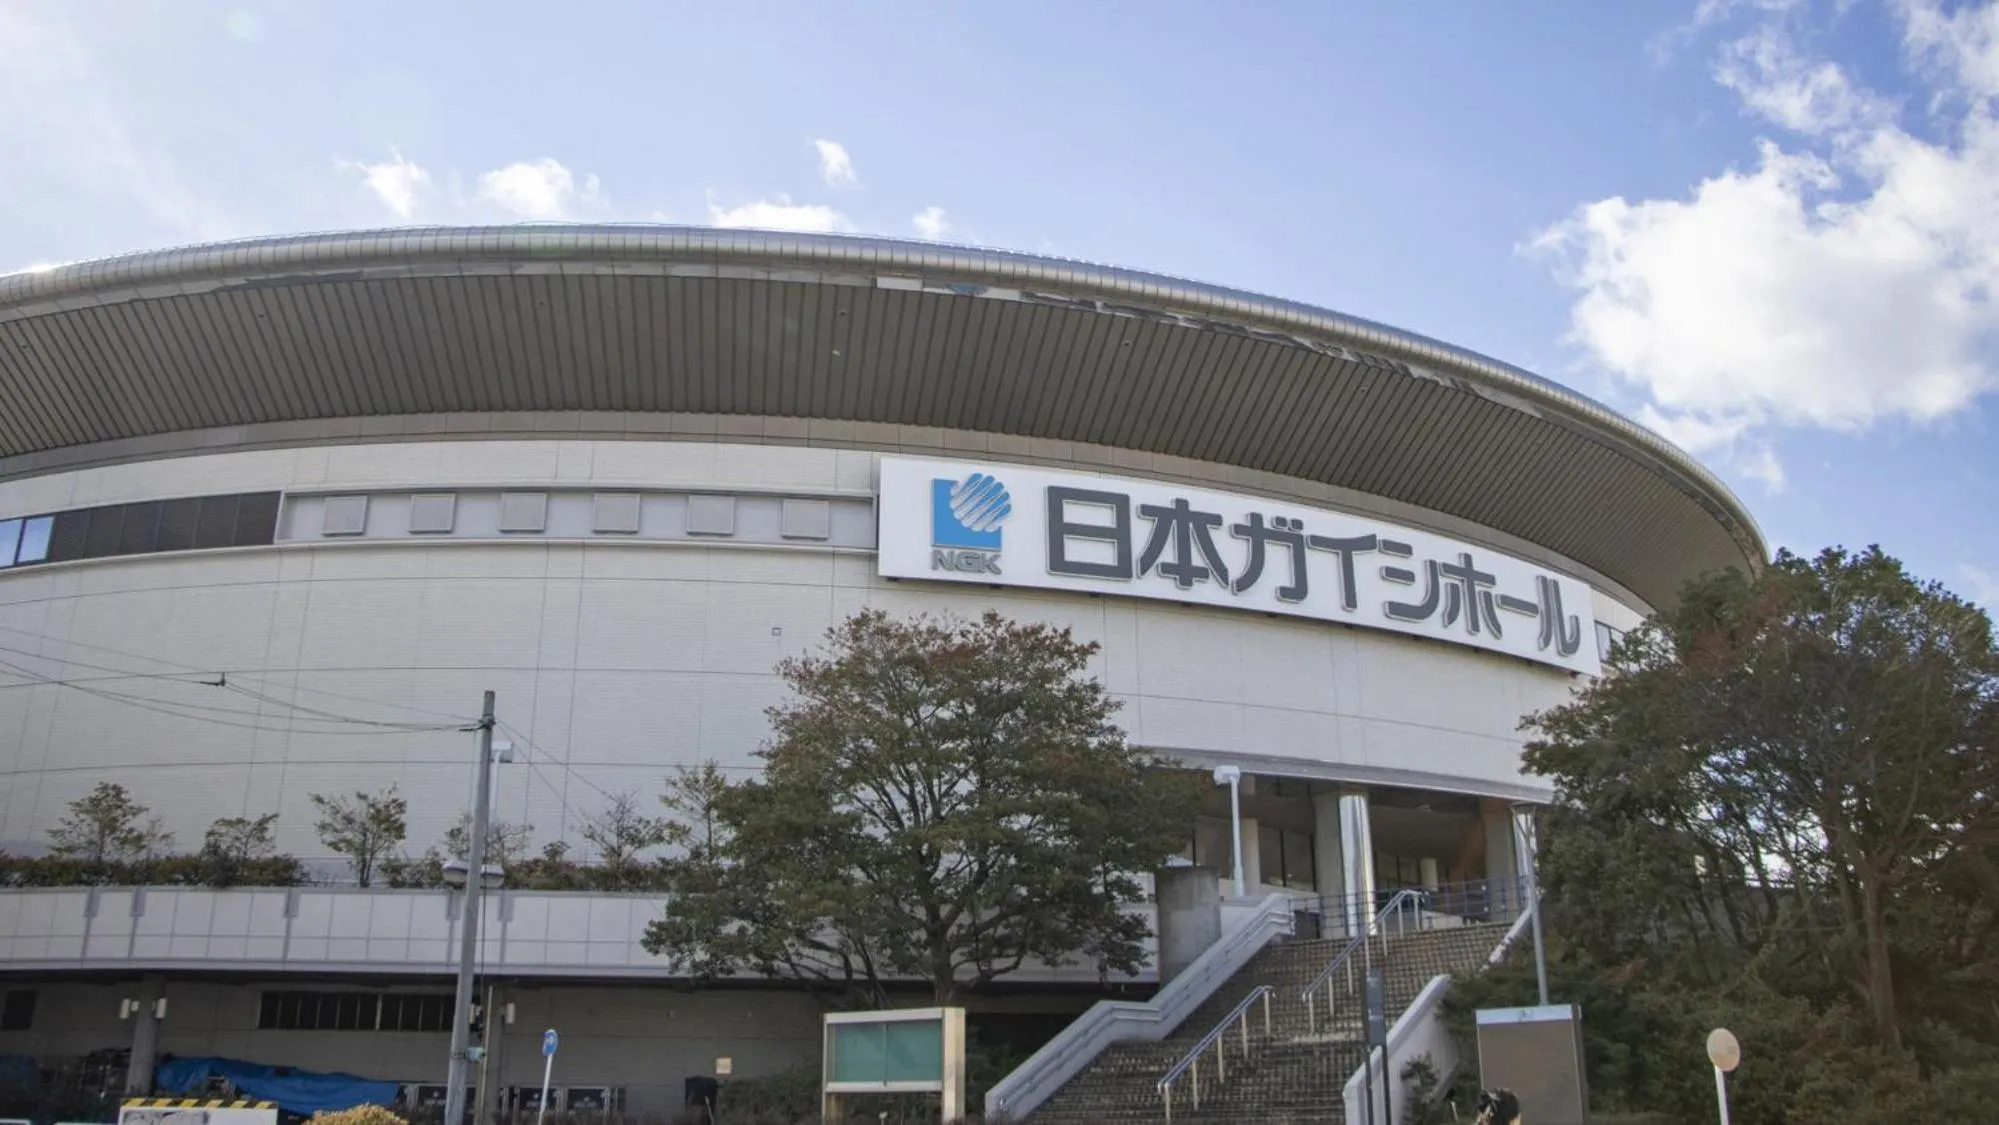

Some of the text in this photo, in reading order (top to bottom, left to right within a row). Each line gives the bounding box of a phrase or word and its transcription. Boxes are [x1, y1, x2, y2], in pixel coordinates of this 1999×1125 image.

[931, 549, 1003, 575] NGK
[1044, 485, 1580, 657] 日本ガイシホール
